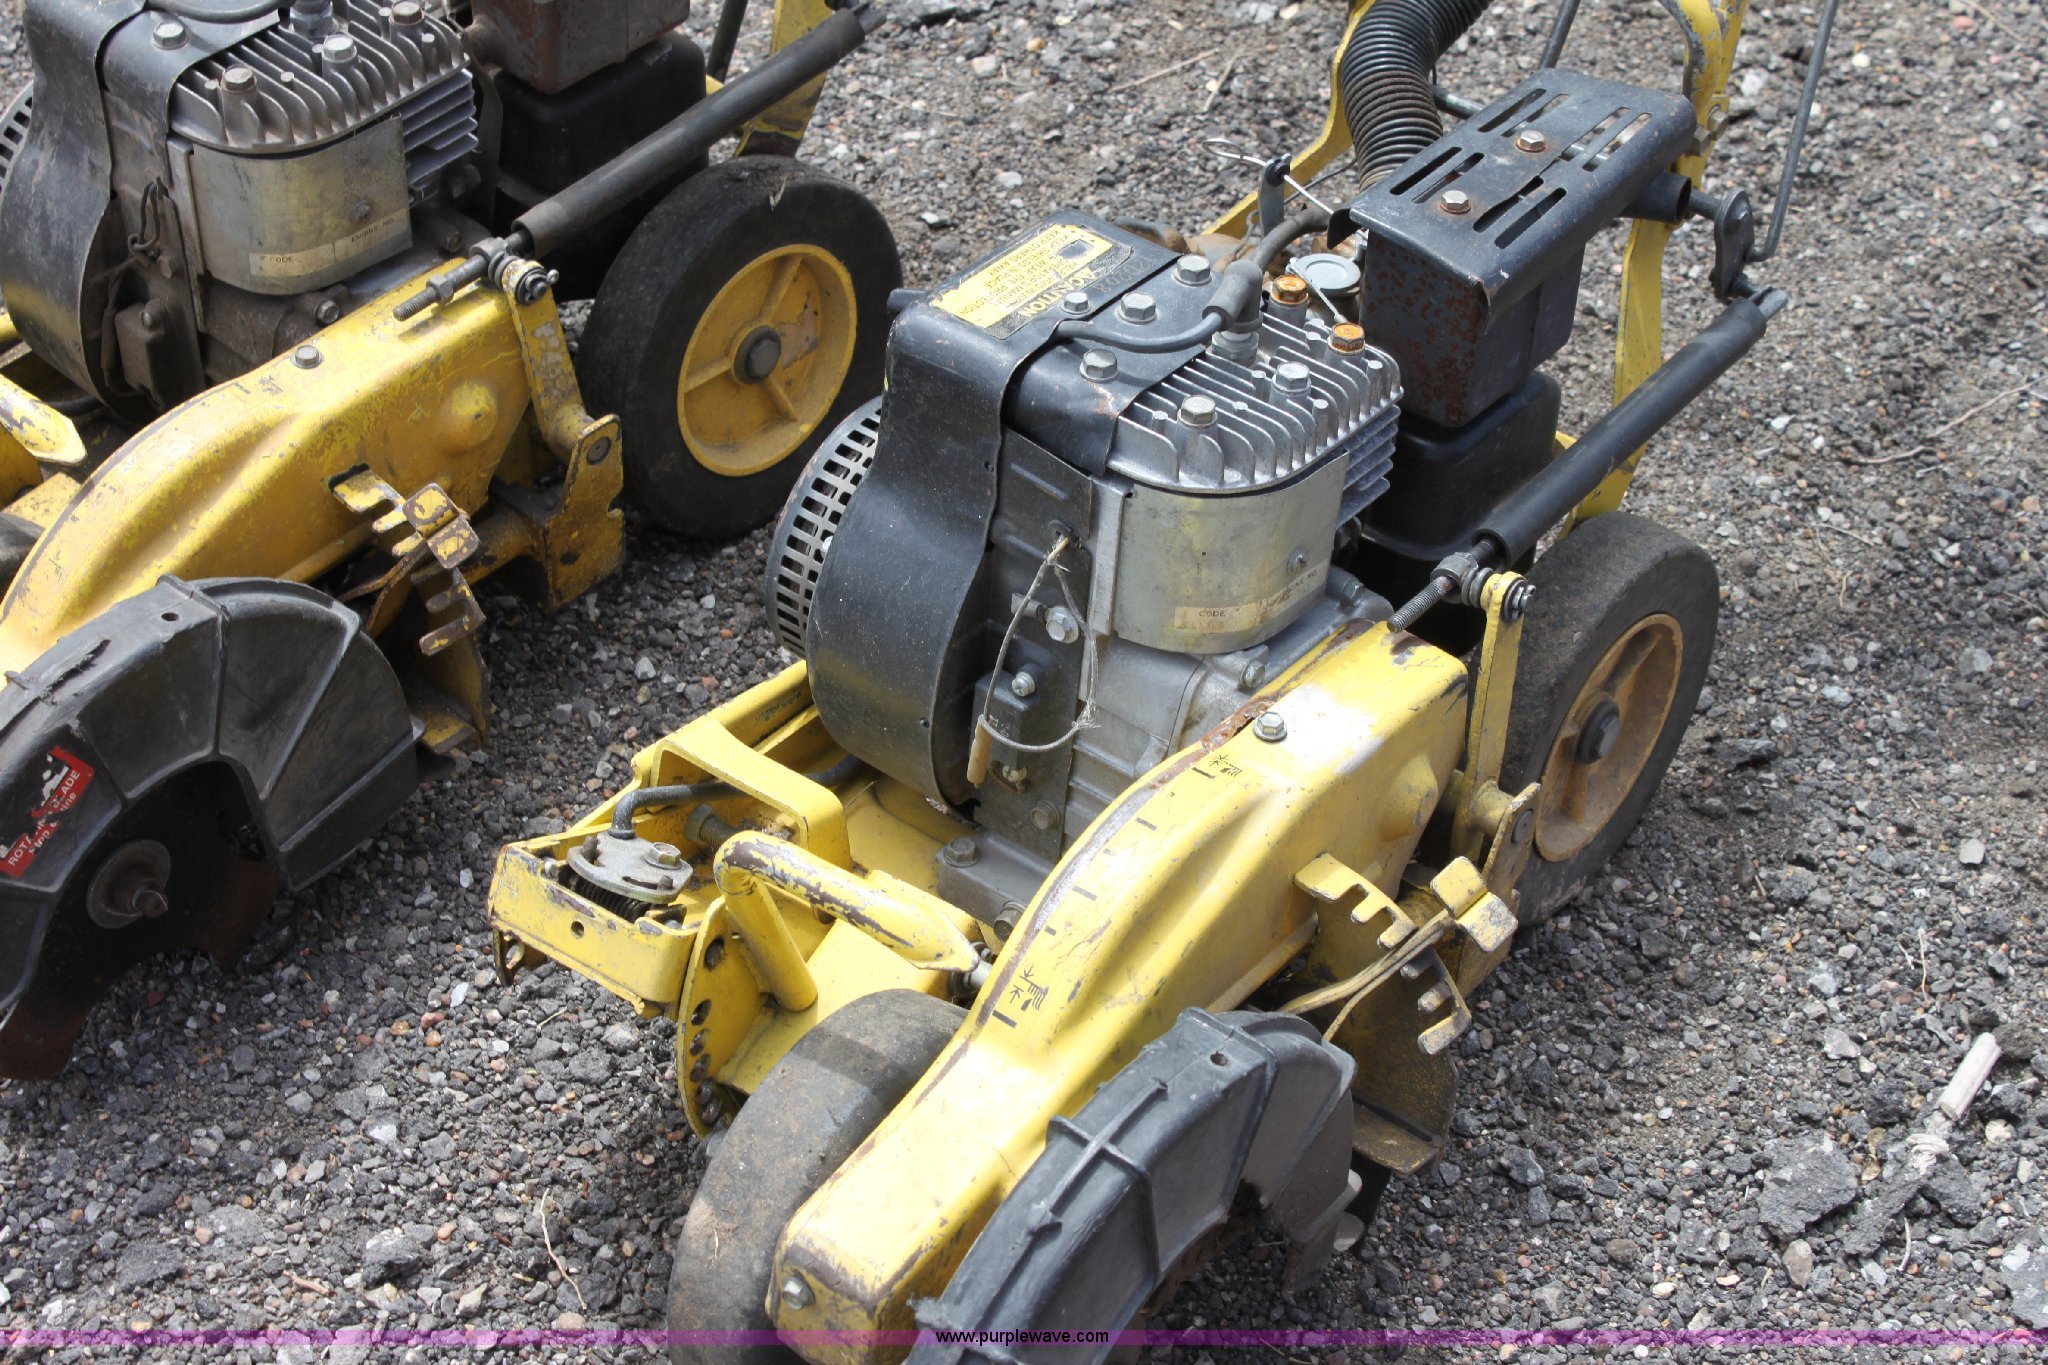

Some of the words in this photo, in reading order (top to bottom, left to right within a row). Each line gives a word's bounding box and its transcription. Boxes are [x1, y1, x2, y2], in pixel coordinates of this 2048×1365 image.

[1036, 229, 1062, 244] KEEP
[1007, 242, 1041, 262] OTHERS
[1015, 247, 1050, 267] SHIELDS
[985, 260, 1011, 276] AWAY
[957, 283, 1009, 316] PROTECTION
